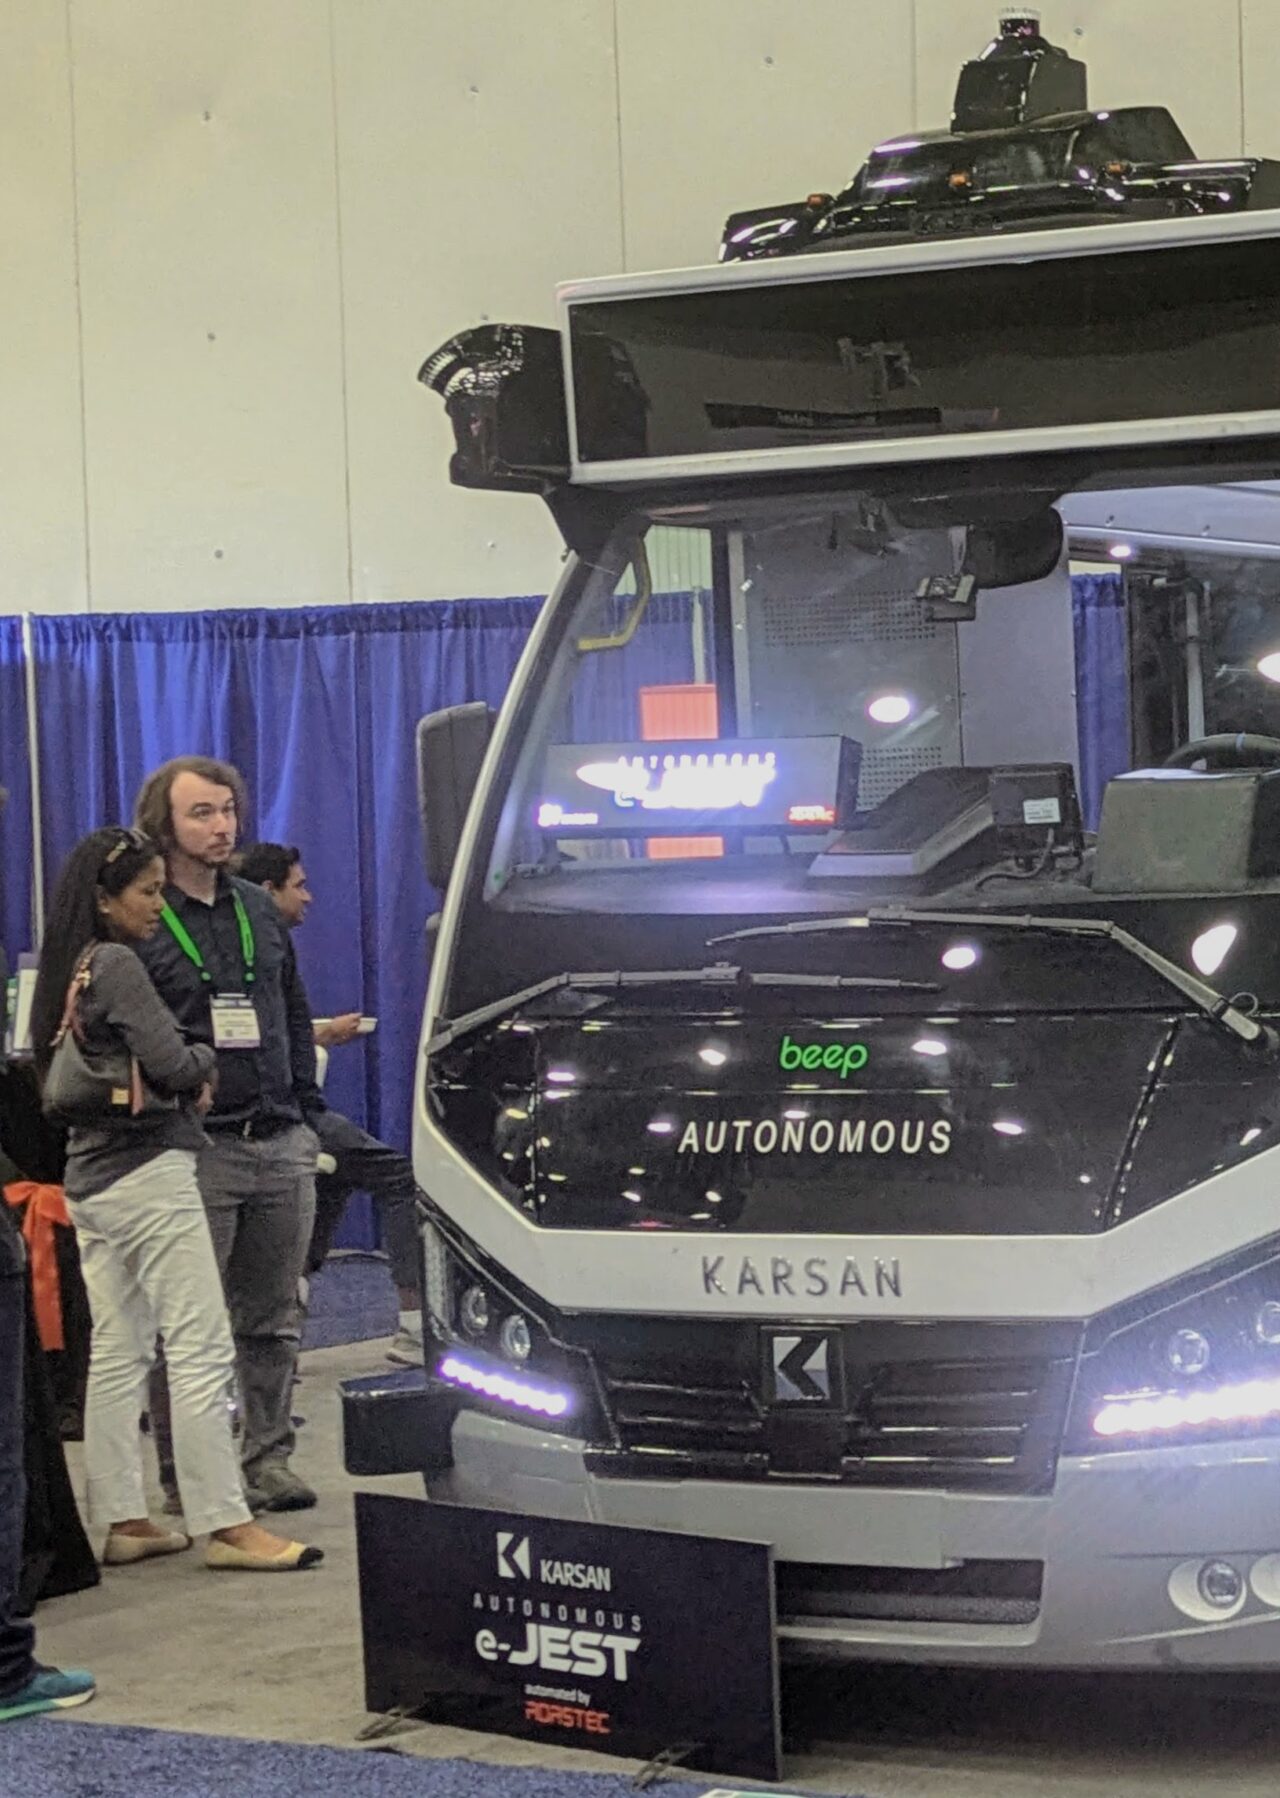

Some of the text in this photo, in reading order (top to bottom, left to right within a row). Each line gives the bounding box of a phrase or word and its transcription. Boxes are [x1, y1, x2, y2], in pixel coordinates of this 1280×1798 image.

[780, 1035, 868, 1079] beep
[677, 1119, 952, 1154] AUTONOMOUS
[702, 1255, 902, 1298] KARSAN
[540, 1559, 611, 1592] KARSAN
[473, 1592, 641, 1632] AUTONOMOUS
[475, 1622, 641, 1682] e-JEST
[577, 1689, 591, 1707] by
